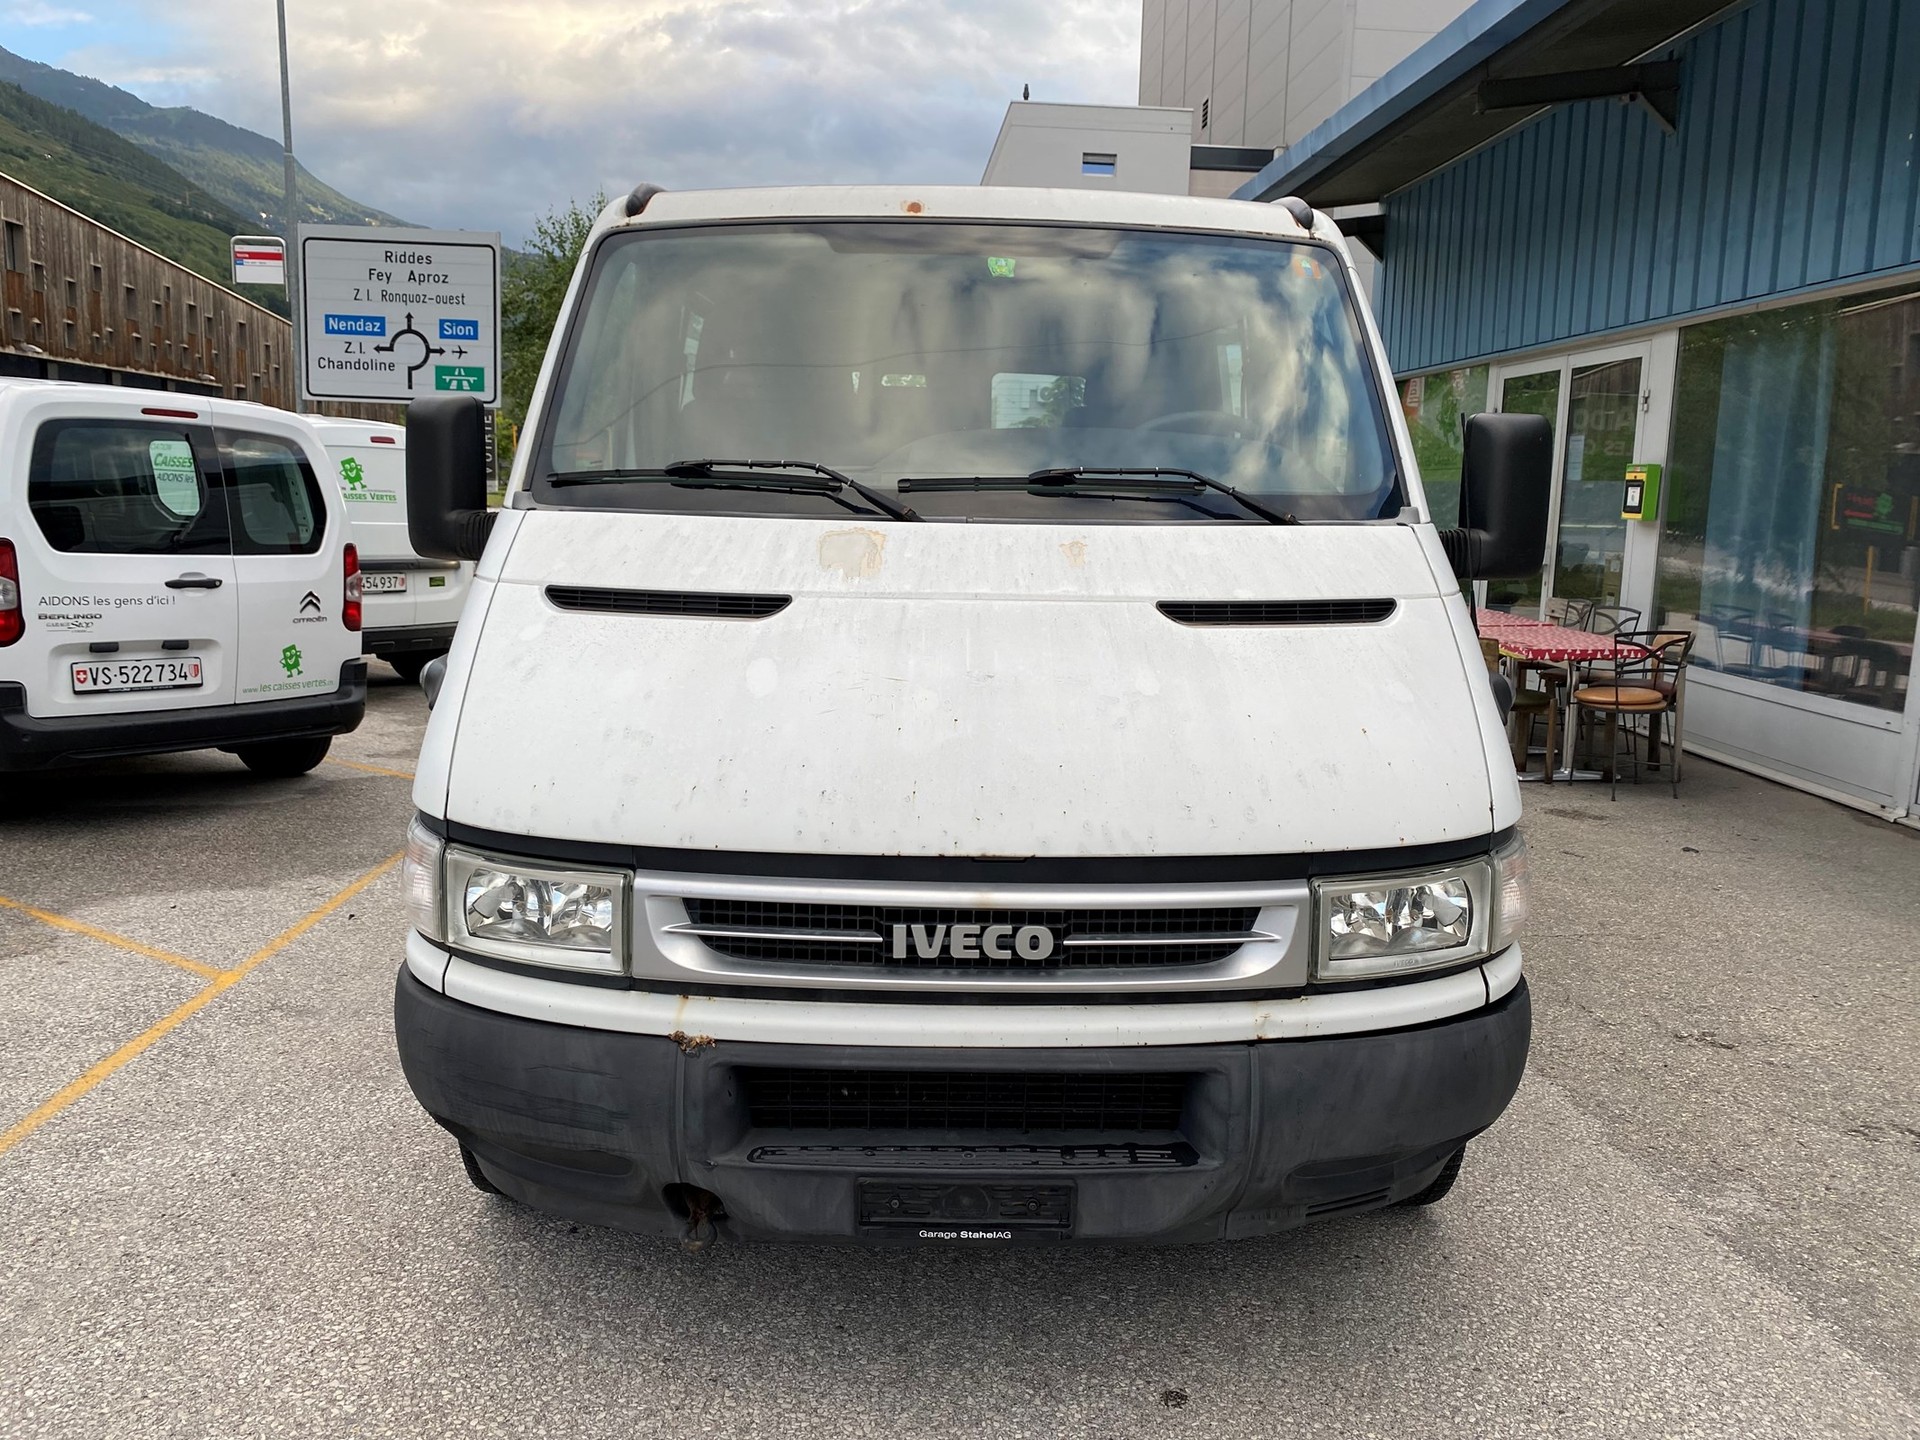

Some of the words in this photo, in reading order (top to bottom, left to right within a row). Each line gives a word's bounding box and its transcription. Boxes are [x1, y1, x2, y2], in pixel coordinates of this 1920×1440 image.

[384, 250, 433, 265] Riddes
[368, 268, 392, 284] Fey
[407, 270, 449, 284] Aproz
[380, 291, 466, 305] Ronquoz-ouest
[328, 318, 382, 333] Nendaz
[442, 322, 475, 336] Sion
[317, 357, 396, 371] Chandoline
[154, 453, 194, 468] CAISSES
[38, 595, 90, 607] AIDONS
[93, 595, 111, 606] les
[114, 596, 143, 609] gens
[892, 923, 1054, 960] IVECO
[918, 1229, 958, 1240] Garage
